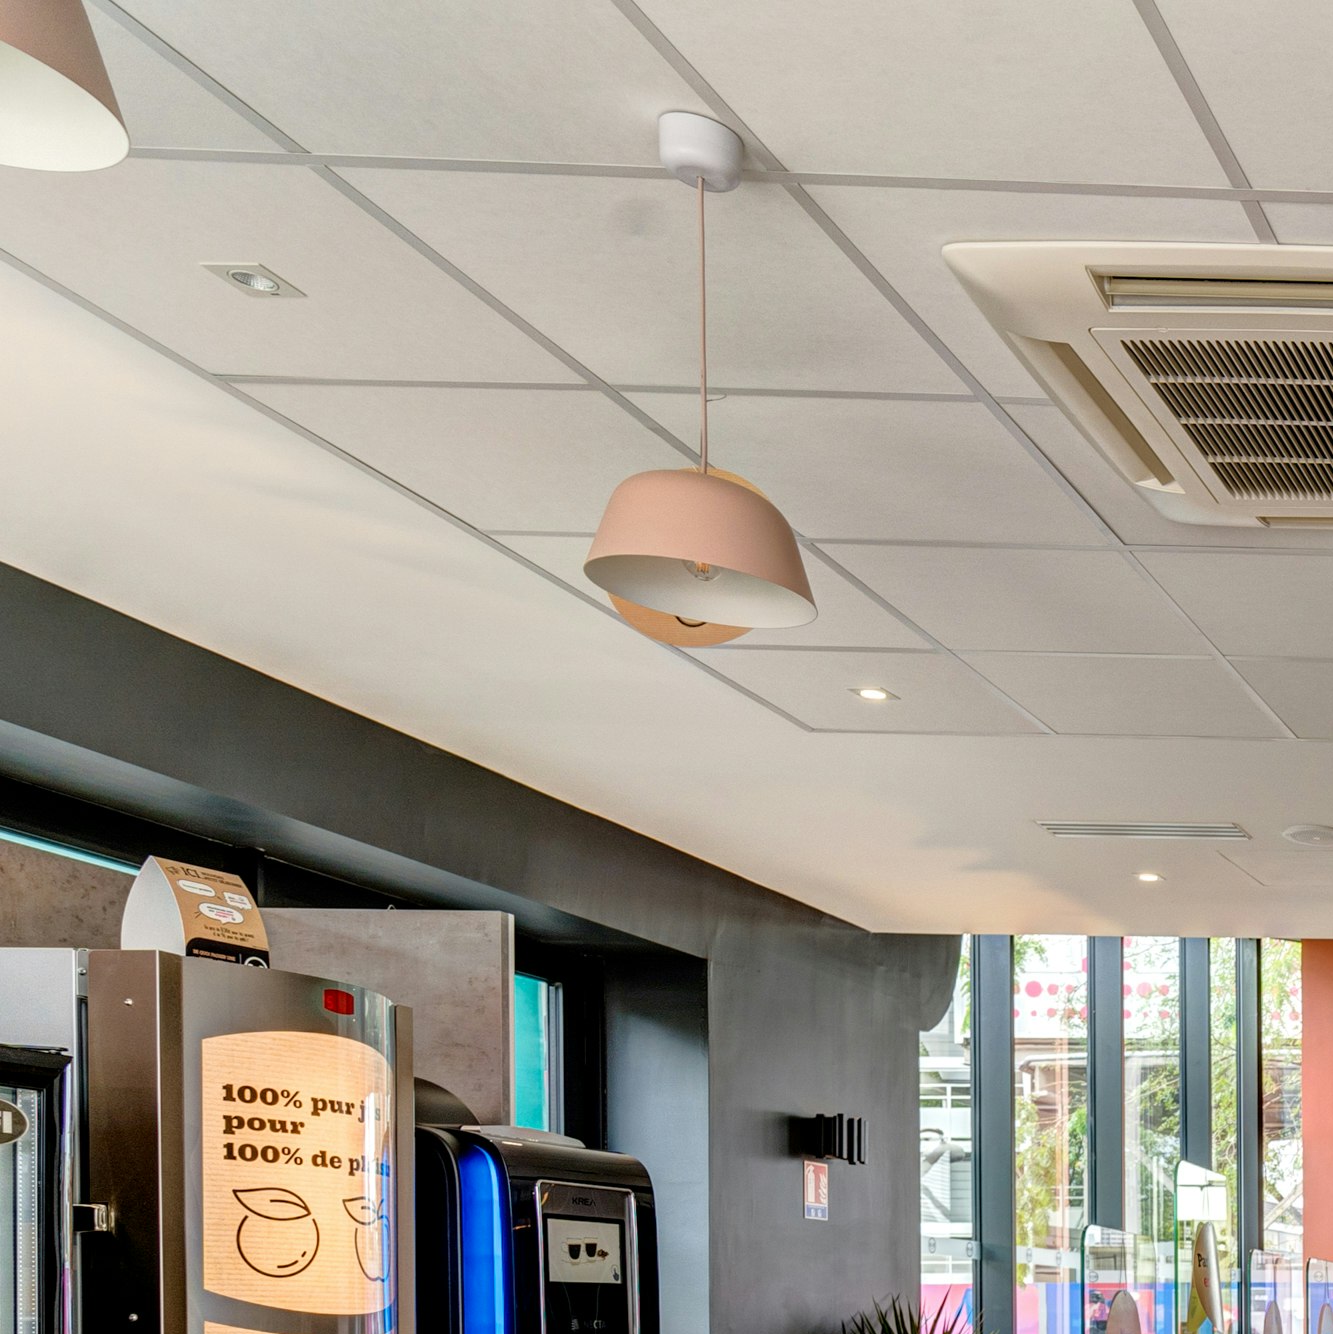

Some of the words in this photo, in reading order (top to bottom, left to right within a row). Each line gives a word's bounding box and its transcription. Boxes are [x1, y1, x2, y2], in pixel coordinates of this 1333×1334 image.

[222, 1084, 303, 1108] 100%
[311, 1096, 355, 1116] pur
[358, 1101, 381, 1123] js
[223, 1114, 305, 1135] pour
[223, 1142, 304, 1166] 100%
[311, 1150, 342, 1169] de
